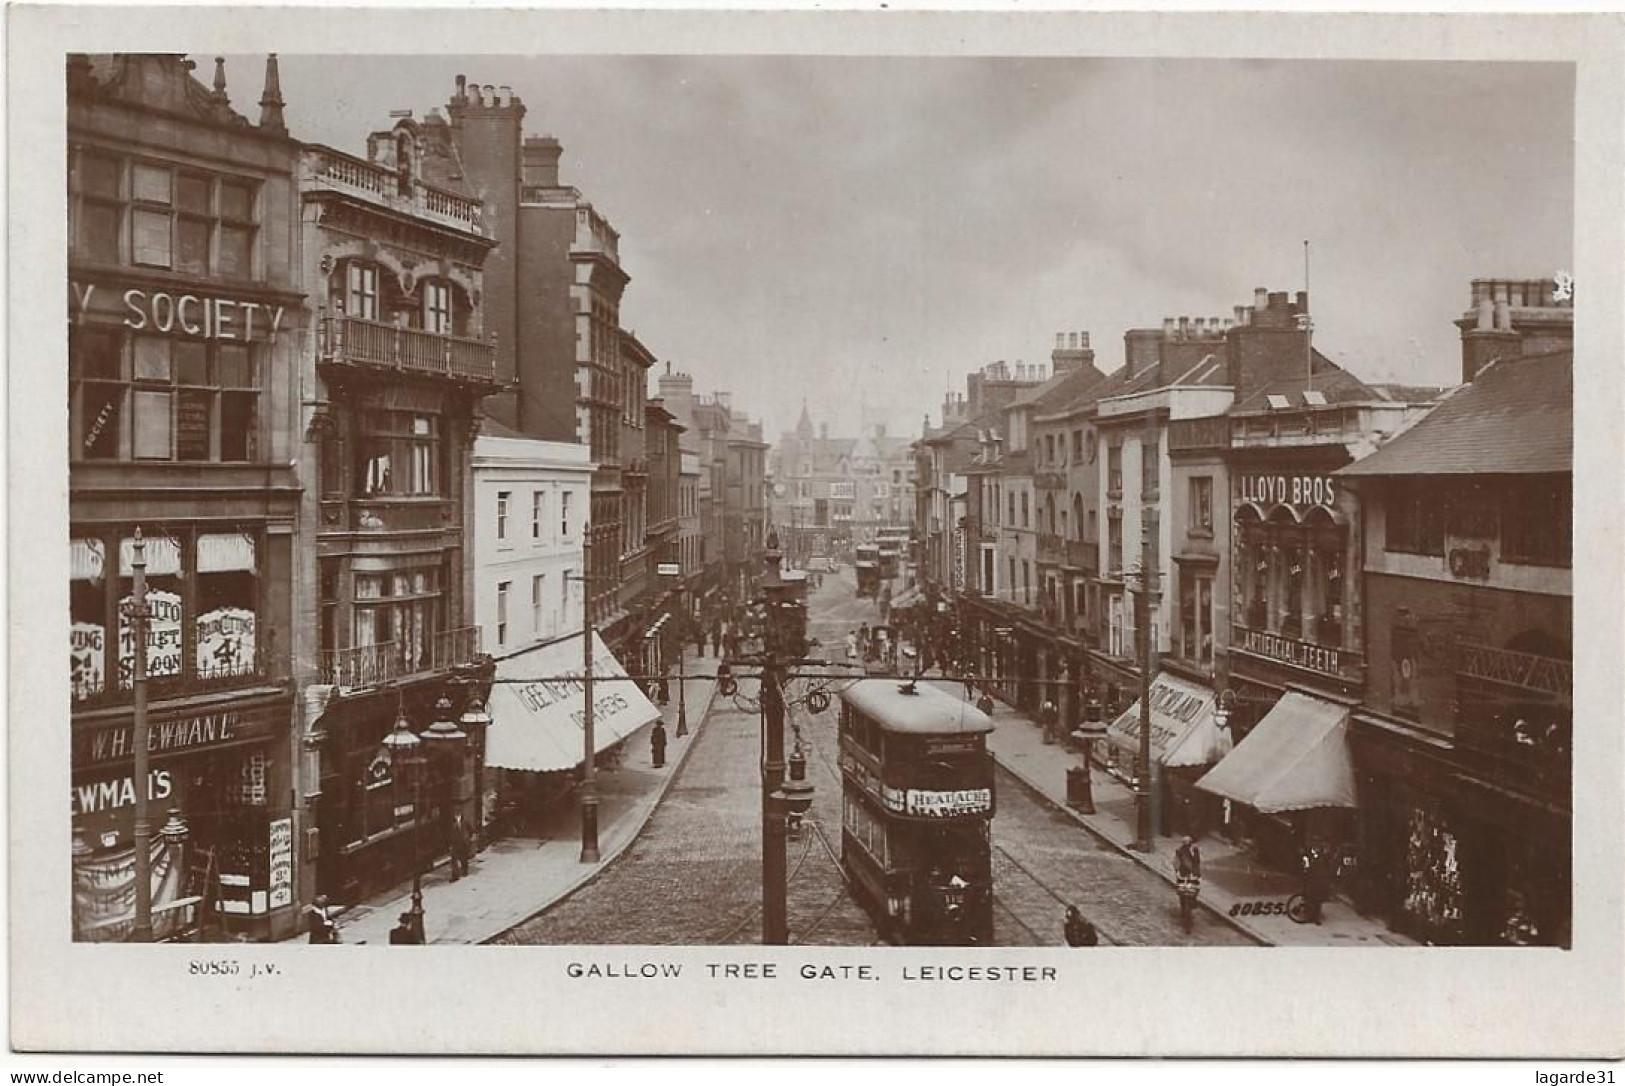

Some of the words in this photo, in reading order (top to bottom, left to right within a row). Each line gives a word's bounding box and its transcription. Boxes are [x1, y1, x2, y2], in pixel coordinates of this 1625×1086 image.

[123, 289, 284, 344] SOCIETY
[1242, 476, 1287, 503] LLOYD
[1293, 477, 1336, 505] BROS
[1245, 631, 1298, 660] ARTIFICIAL
[1302, 645, 1339, 673] TEETH
[131, 715, 217, 754] EWMAN
